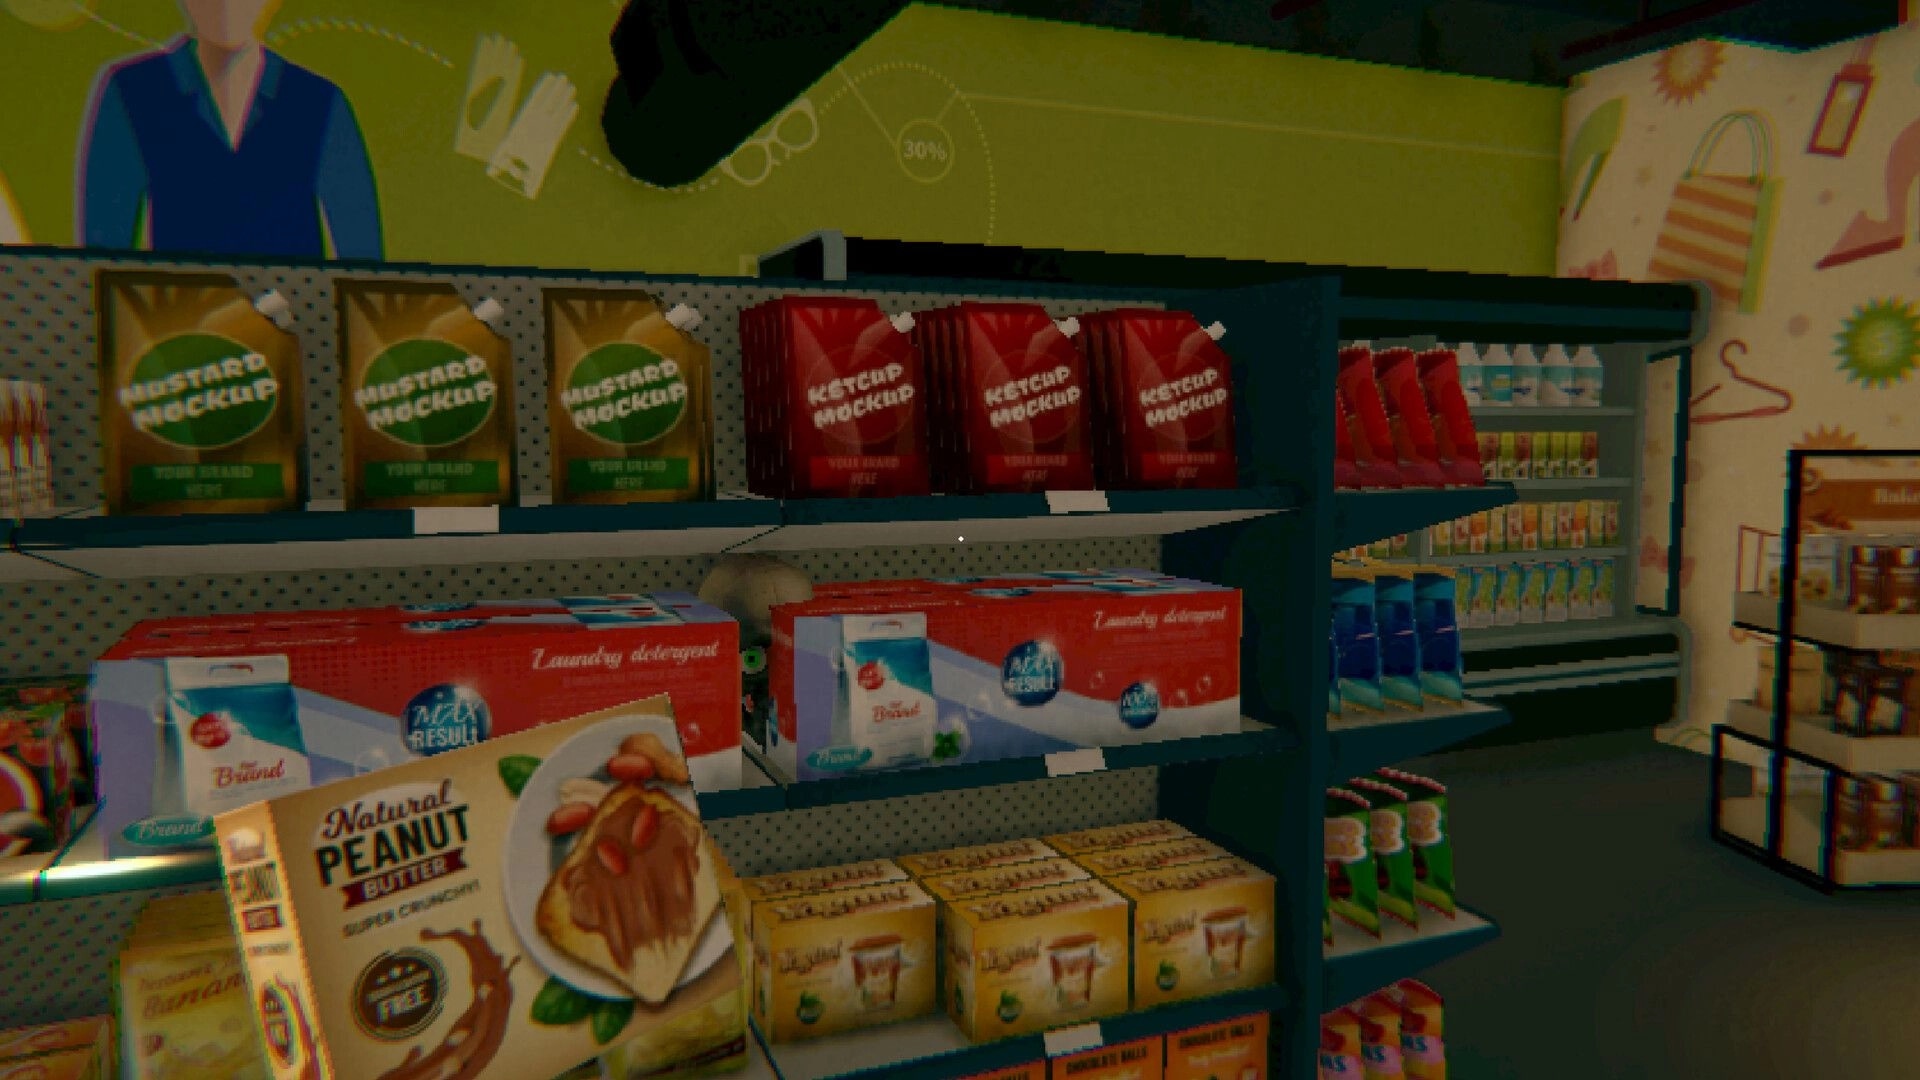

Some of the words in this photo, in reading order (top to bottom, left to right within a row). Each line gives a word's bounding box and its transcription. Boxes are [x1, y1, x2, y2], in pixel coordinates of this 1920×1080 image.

[903, 139, 946, 162] 30%
[117, 353, 267, 408] MUSTARD
[355, 355, 487, 408] MUSTARD
[560, 358, 678, 408] MUSTARD
[807, 362, 903, 405] KETCUP
[984, 365, 1071, 407] KETCUP
[1139, 366, 1217, 407] KETCUP
[131, 378, 277, 431] MOCKUP
[368, 380, 497, 430] MOCKUP
[573, 382, 687, 430] MOCKUP
[813, 383, 915, 430] MOCKUP
[990, 386, 1081, 430] MOCKUP
[1145, 388, 1227, 429] MOCKUP
[1093, 608, 1158, 630] Laundry
[532, 646, 623, 670] Laundry
[630, 640, 720, 664] detergent
[214, 759, 285, 788] Brand
[323, 779, 452, 839] Natural
[315, 803, 469, 887] PEANUT
[363, 856, 447, 900] BUTTER
[342, 909, 395, 937] SUPER
[376, 985, 433, 1025] FREE
